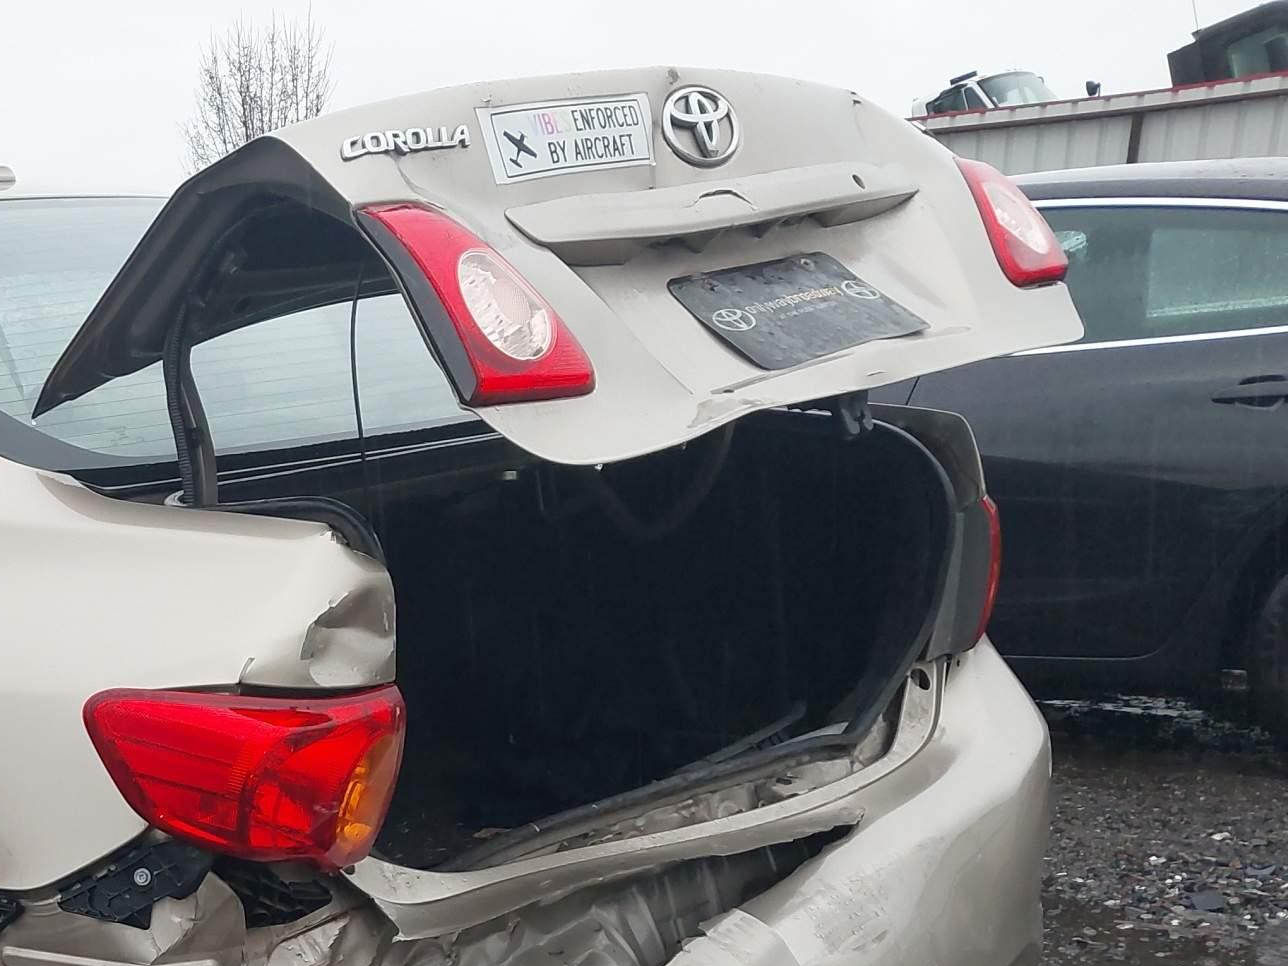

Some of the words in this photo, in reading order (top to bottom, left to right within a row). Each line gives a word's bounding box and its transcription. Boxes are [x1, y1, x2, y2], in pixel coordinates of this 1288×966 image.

[571, 105, 640, 132] ENFORCED
[341, 124, 471, 161] COROLLA
[548, 140, 568, 164] BY
[574, 134, 635, 161] AIRCRAFT
